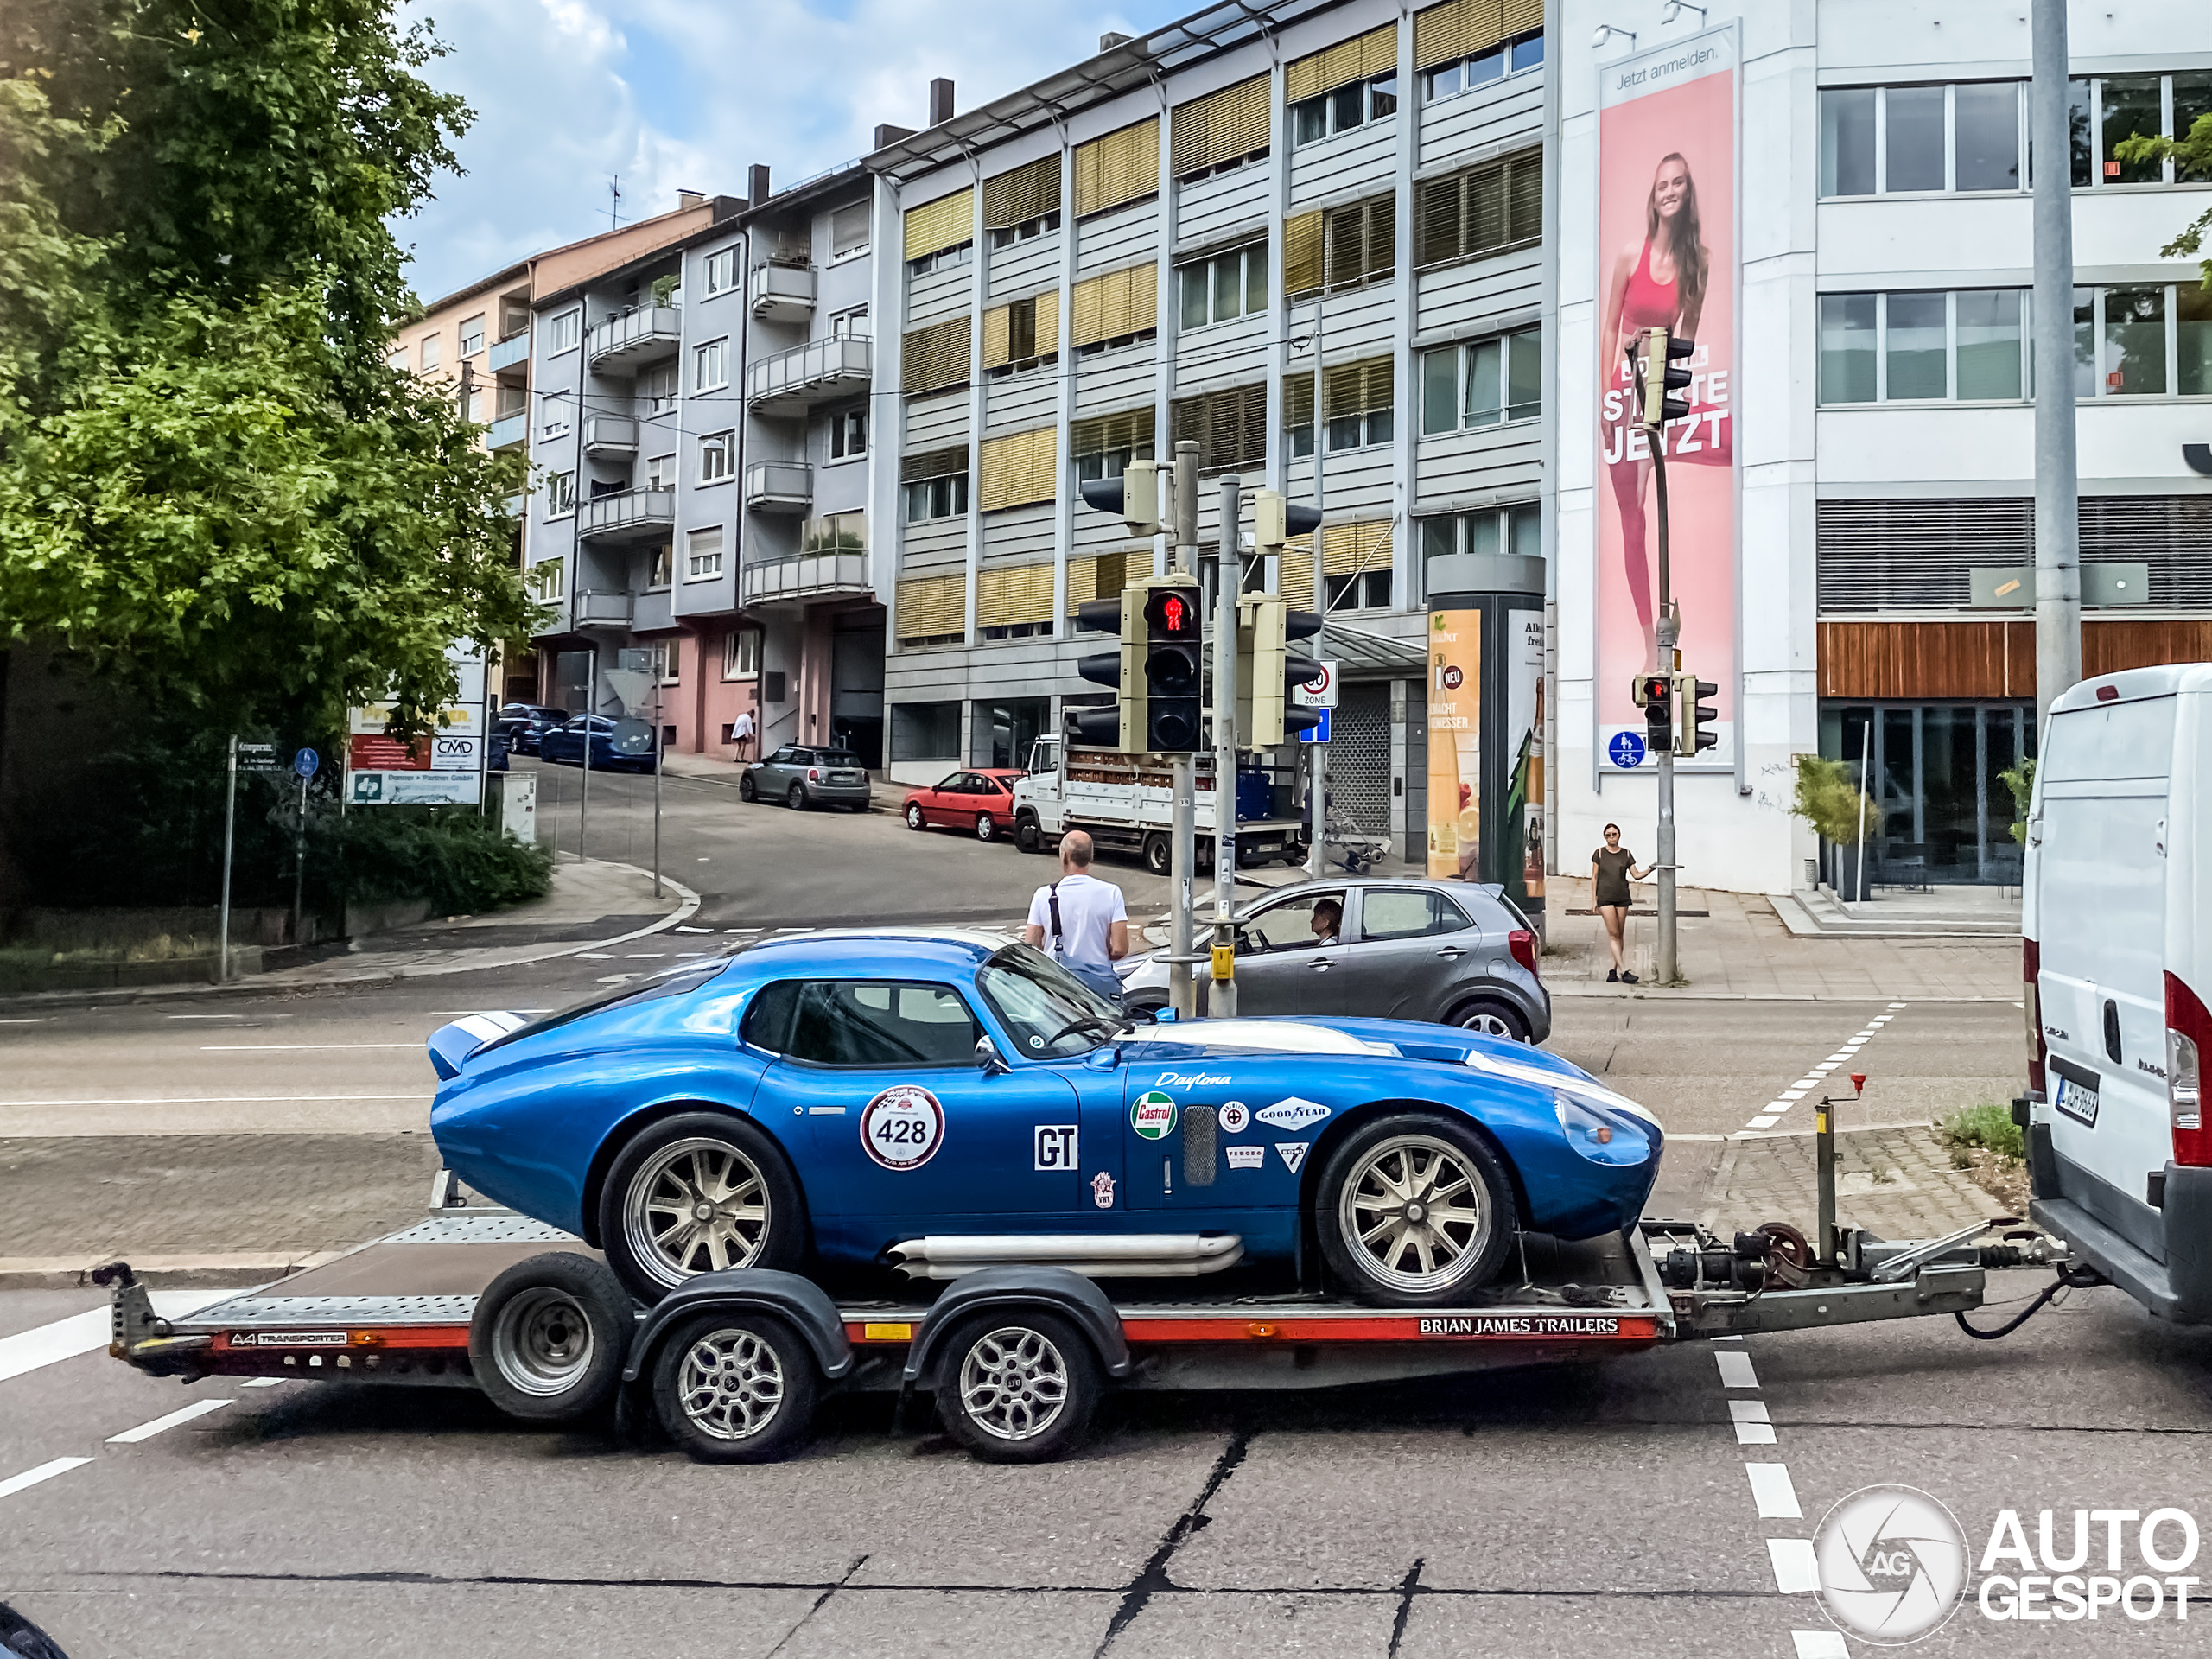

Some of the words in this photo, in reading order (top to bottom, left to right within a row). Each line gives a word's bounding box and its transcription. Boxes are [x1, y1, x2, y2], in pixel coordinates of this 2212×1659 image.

[1617, 68, 1647, 90] Jetzt
[1650, 48, 1718, 79] anmelden.
[1445, 671, 1460, 684] NEU
[438, 740, 473, 753] CMD
[1155, 1071, 1232, 1091] Daytona
[1138, 1104, 1171, 1119] Castrol
[876, 1119, 925, 1144] 428
[1038, 1128, 1075, 1167] GT
[1420, 1319, 1471, 1332] BRIAN
[1474, 1319, 1530, 1334] JAMES
[1535, 1319, 1618, 1332] TRAILERS
[231, 1332, 256, 1344] A4
[260, 1334, 346, 1344] TRANSPORTER
